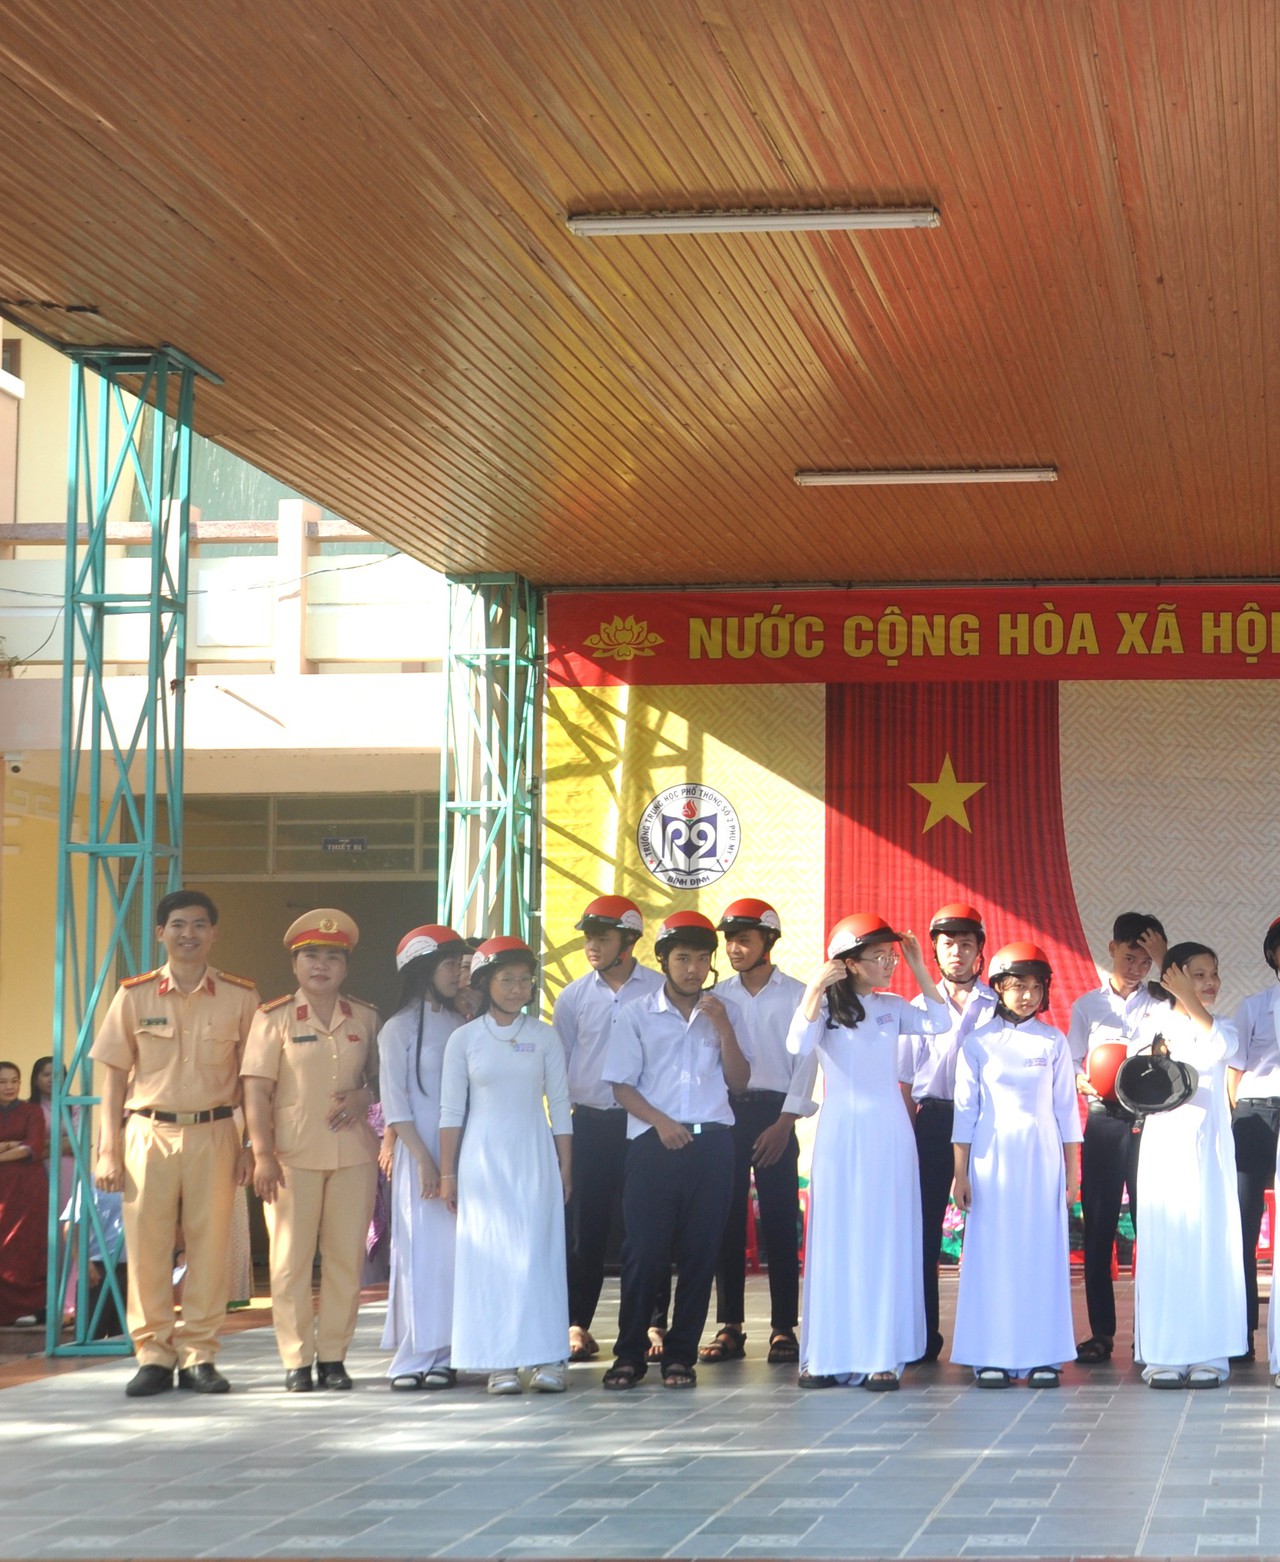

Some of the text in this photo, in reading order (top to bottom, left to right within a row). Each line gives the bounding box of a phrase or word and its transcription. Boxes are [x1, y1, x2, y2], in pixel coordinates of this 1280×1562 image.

[688, 604, 825, 659] NƯỚC
[842, 606, 980, 666] CỘNG
[998, 602, 1100, 655] HÒA
[1116, 603, 1185, 654] XÃ
[645, 800, 664, 823] TRUNG
